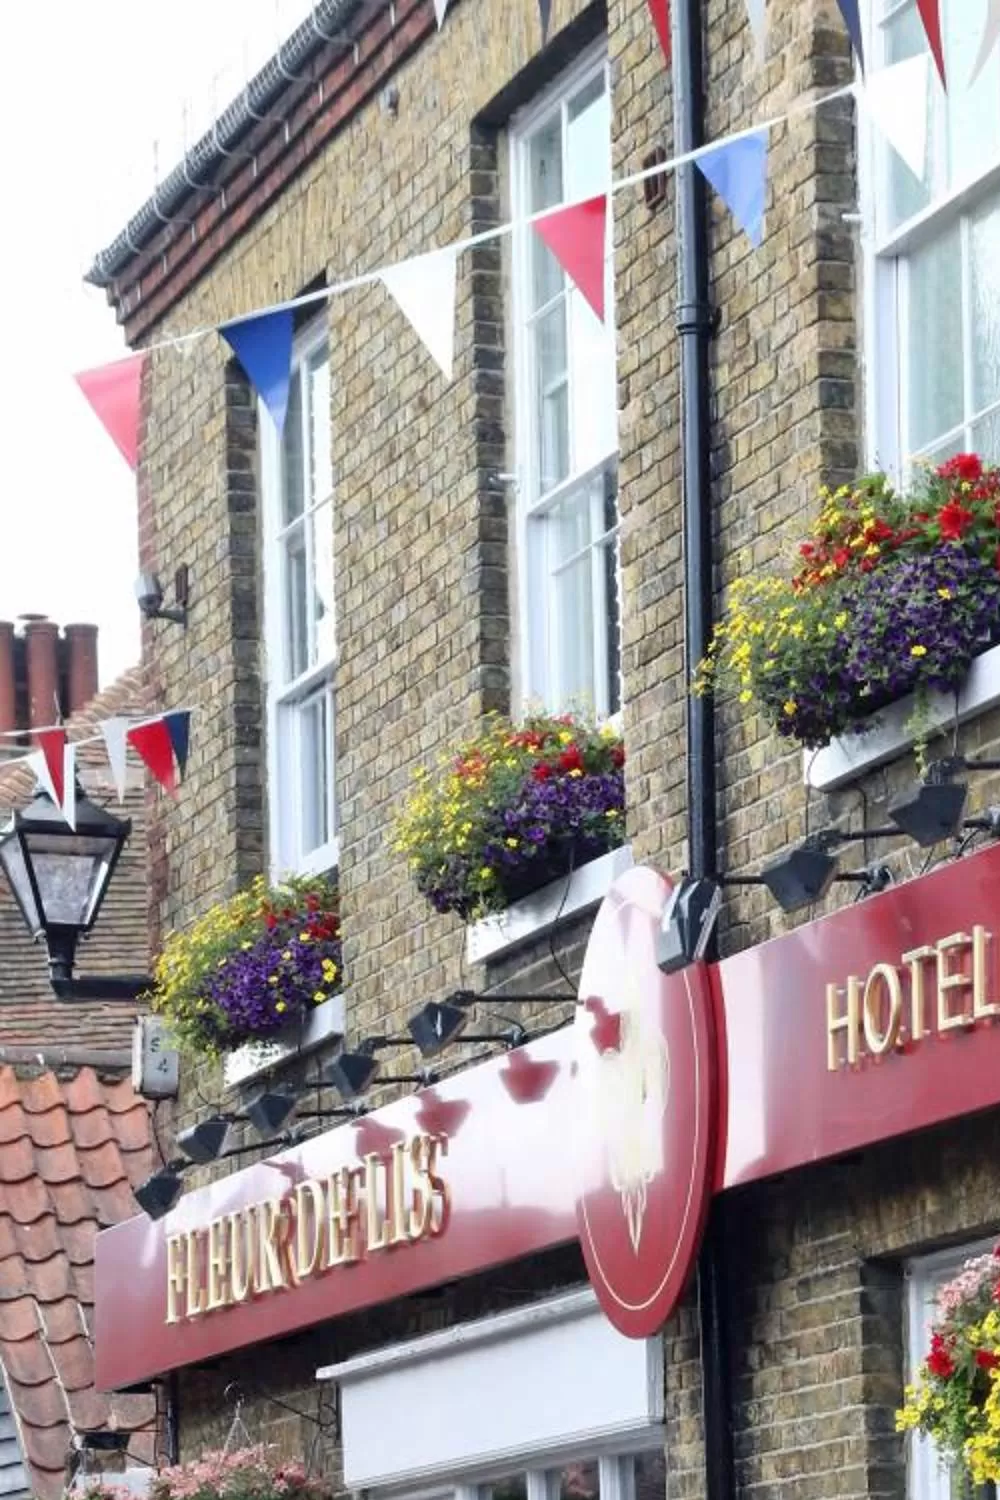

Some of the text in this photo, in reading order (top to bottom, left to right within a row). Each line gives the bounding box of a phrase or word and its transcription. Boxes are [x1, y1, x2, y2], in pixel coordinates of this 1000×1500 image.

[165, 1133, 445, 1324] FLEUR DE LIS
